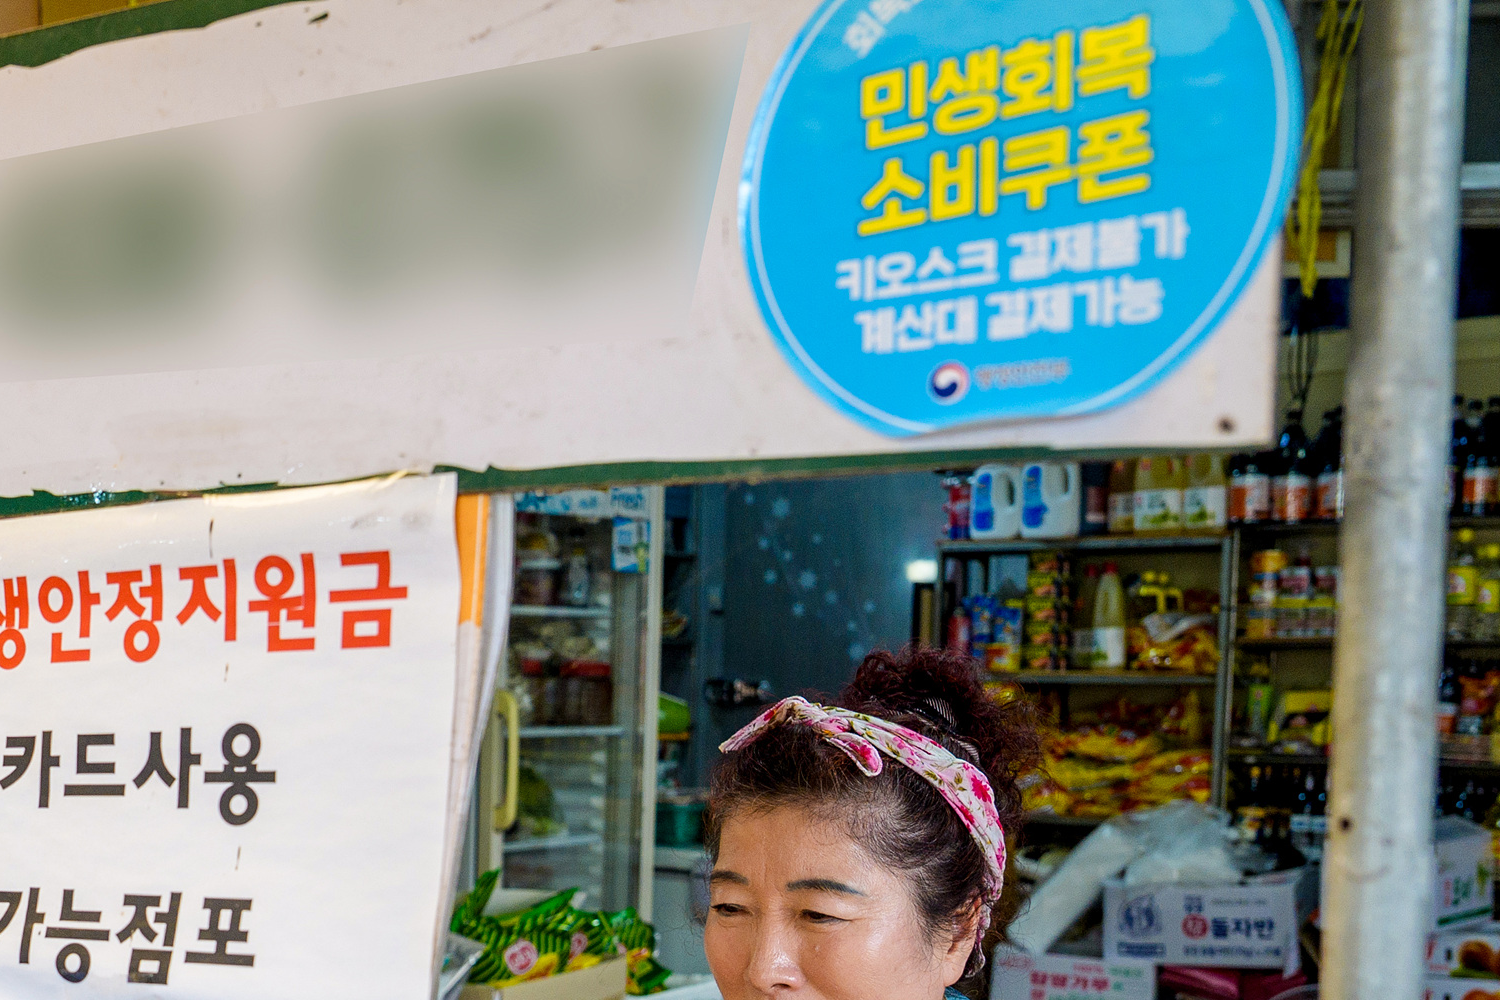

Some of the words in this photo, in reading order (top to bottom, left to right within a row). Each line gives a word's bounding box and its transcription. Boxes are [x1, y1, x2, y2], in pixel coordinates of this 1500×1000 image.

[860, 14, 1154, 150] 민생회복
[856, 110, 1154, 238] 소비쿠폰
[836, 238, 999, 301] 키오스크
[855, 297, 978, 354] 계산대
